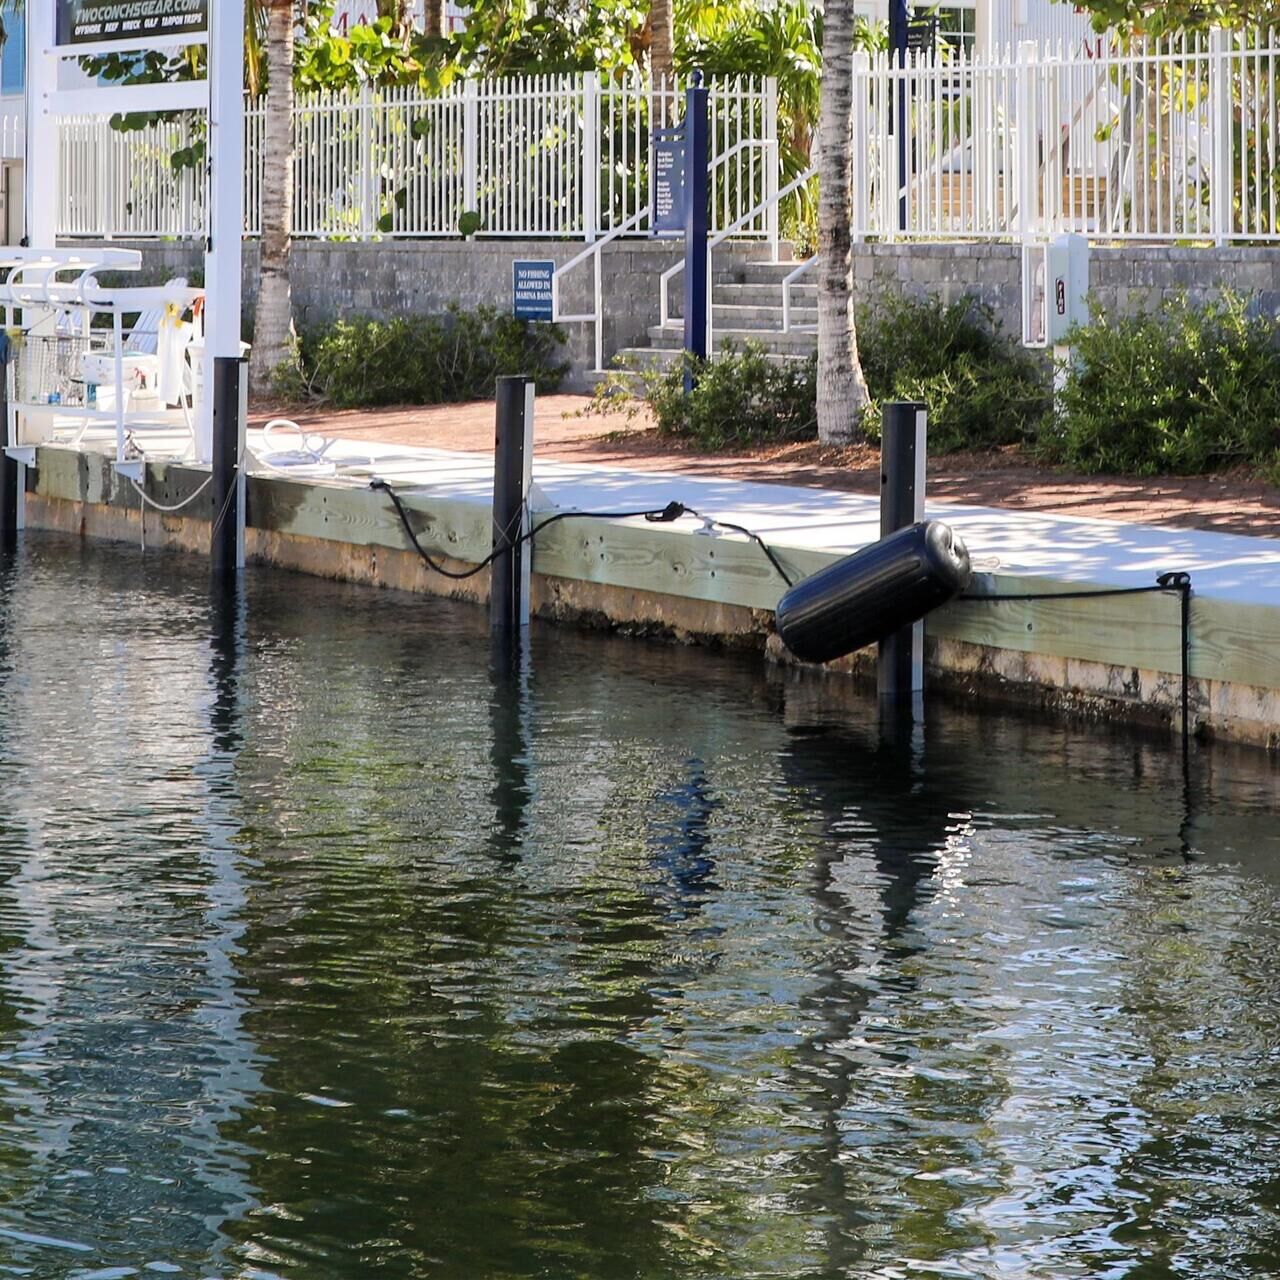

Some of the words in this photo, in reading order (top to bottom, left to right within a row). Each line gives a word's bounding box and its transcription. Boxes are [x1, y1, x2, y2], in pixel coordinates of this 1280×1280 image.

[518, 270, 527, 279] NO
[518, 280, 543, 289] ALLOWED
[543, 280, 551, 289] IN
[515, 290, 537, 300] MARINA
